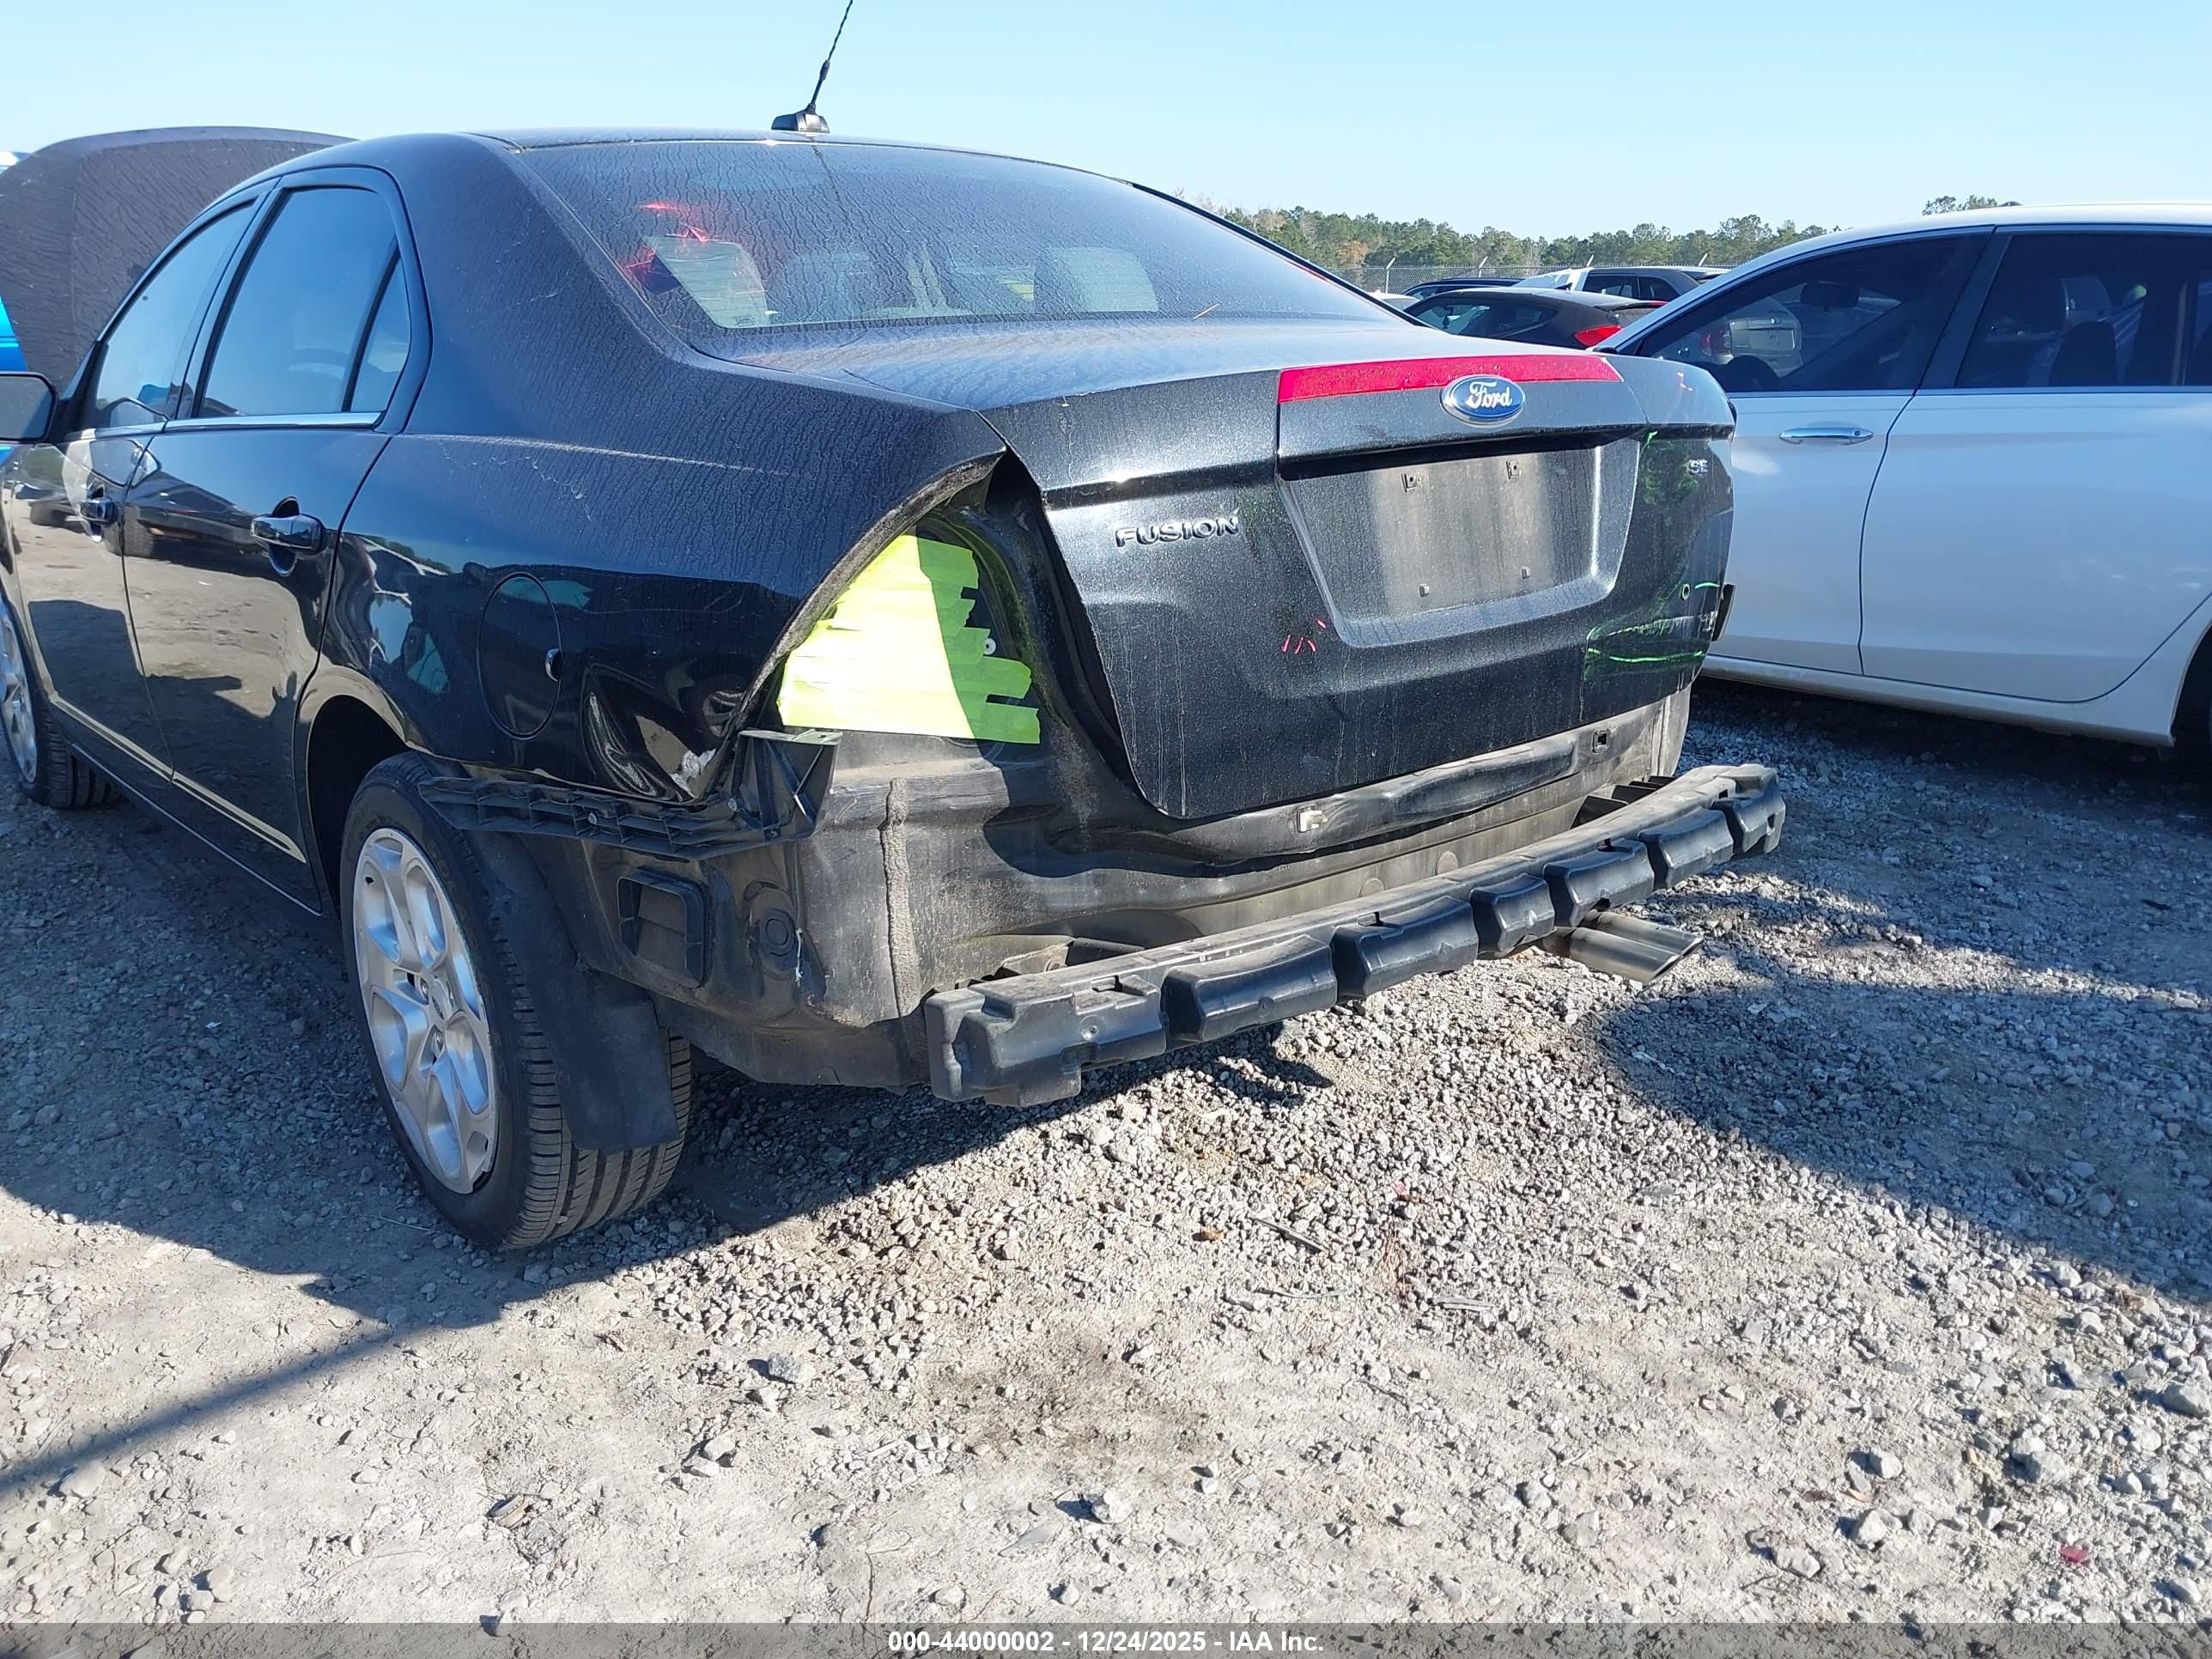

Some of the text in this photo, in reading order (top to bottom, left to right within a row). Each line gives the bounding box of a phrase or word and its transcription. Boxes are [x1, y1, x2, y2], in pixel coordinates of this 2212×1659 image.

[1465, 381, 1512, 409] Ford
[1687, 459, 1709, 475] SE
[1115, 515, 1239, 548] FUSION
